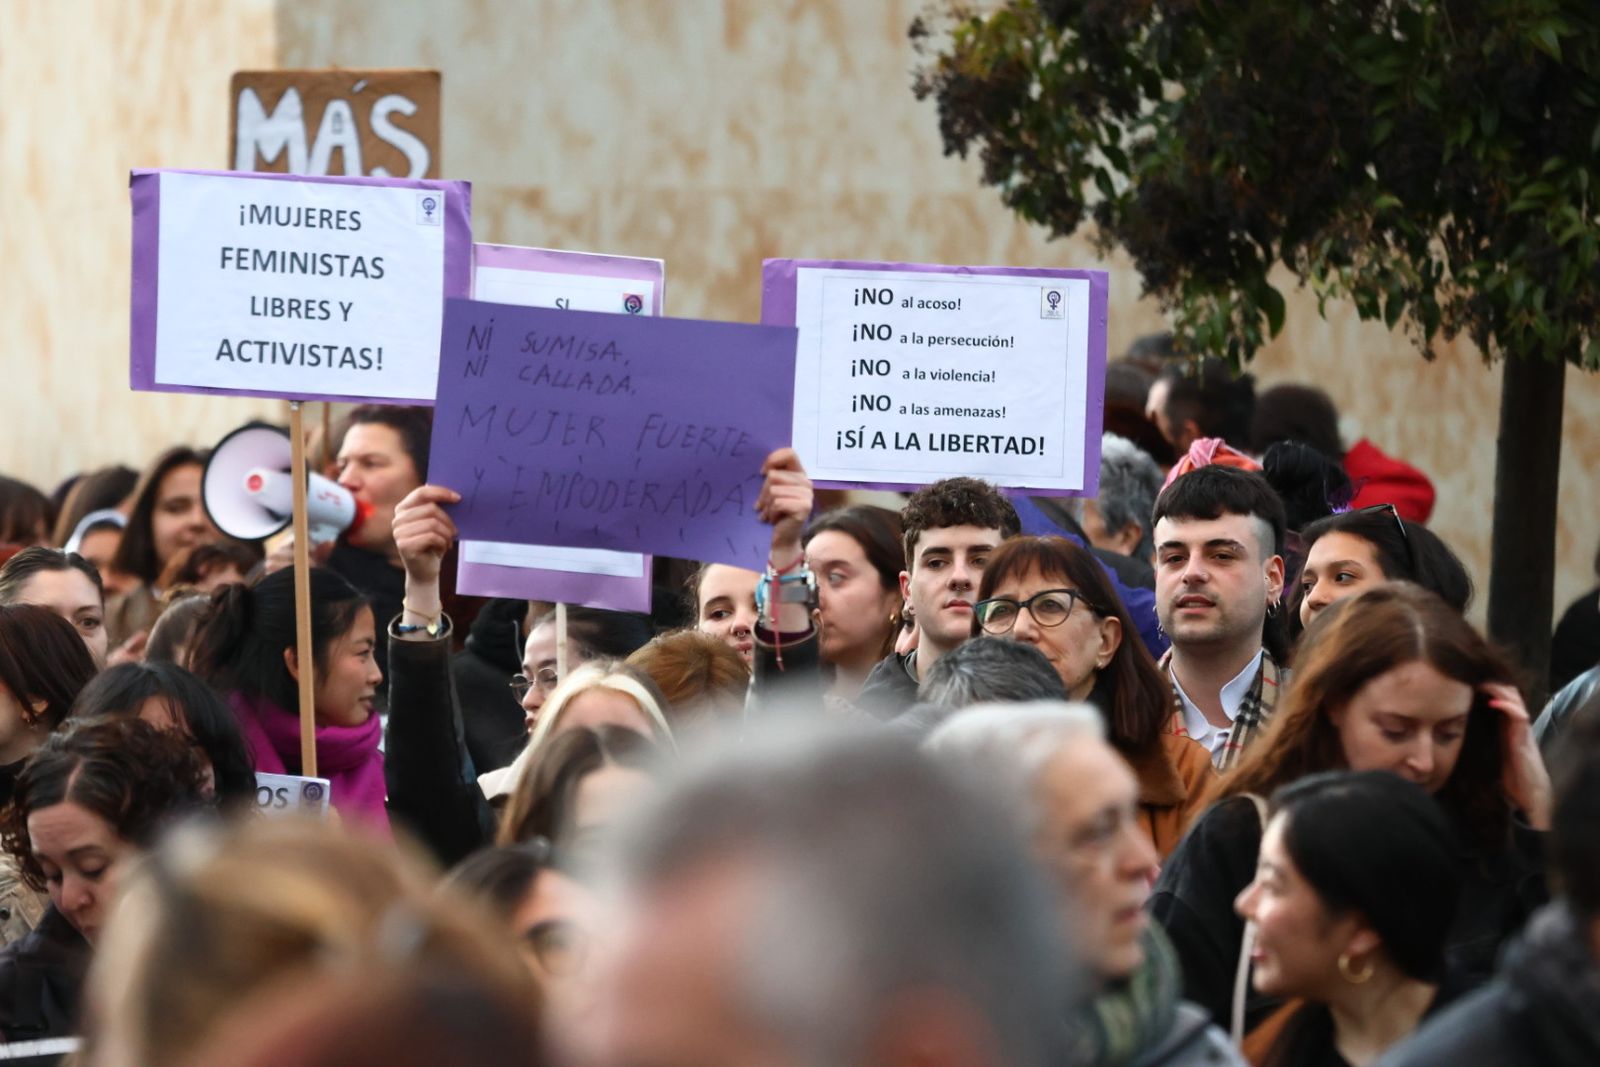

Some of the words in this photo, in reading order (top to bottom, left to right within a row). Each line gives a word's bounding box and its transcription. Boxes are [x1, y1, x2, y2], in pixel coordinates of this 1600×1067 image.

[234, 79, 431, 180] MÁS
[239, 204, 362, 231] ¡MUJERES
[220, 247, 384, 279] FEMINISTAS
[250, 295, 331, 321] LIBRES
[338, 301, 353, 322] Y
[854, 287, 894, 307] ¡NO
[901, 297, 913, 309] al
[917, 298, 961, 311] acoso!
[852, 323, 892, 343] ¡NO
[899, 333, 908, 344] a
[911, 332, 924, 345] la
[927, 333, 1014, 348] persecución!
[216, 339, 383, 371] ACTIVISTAS!
[851, 358, 891, 378] ¡NO
[902, 369, 910, 380] a
[914, 368, 926, 381] la
[930, 369, 995, 383] violencia!
[852, 394, 892, 414] ¡NO
[899, 405, 907, 415] a
[911, 403, 930, 416] las
[933, 404, 1006, 419] amenazas!
[457, 404, 606, 448] MUJER
[635, 413, 754, 458] FUERTE
[836, 425, 865, 451] ¡SÍ
[871, 431, 887, 450] A
[894, 432, 921, 451] LA
[928, 433, 1045, 456] LIBERTAD!
[468, 467, 486, 513] Y
